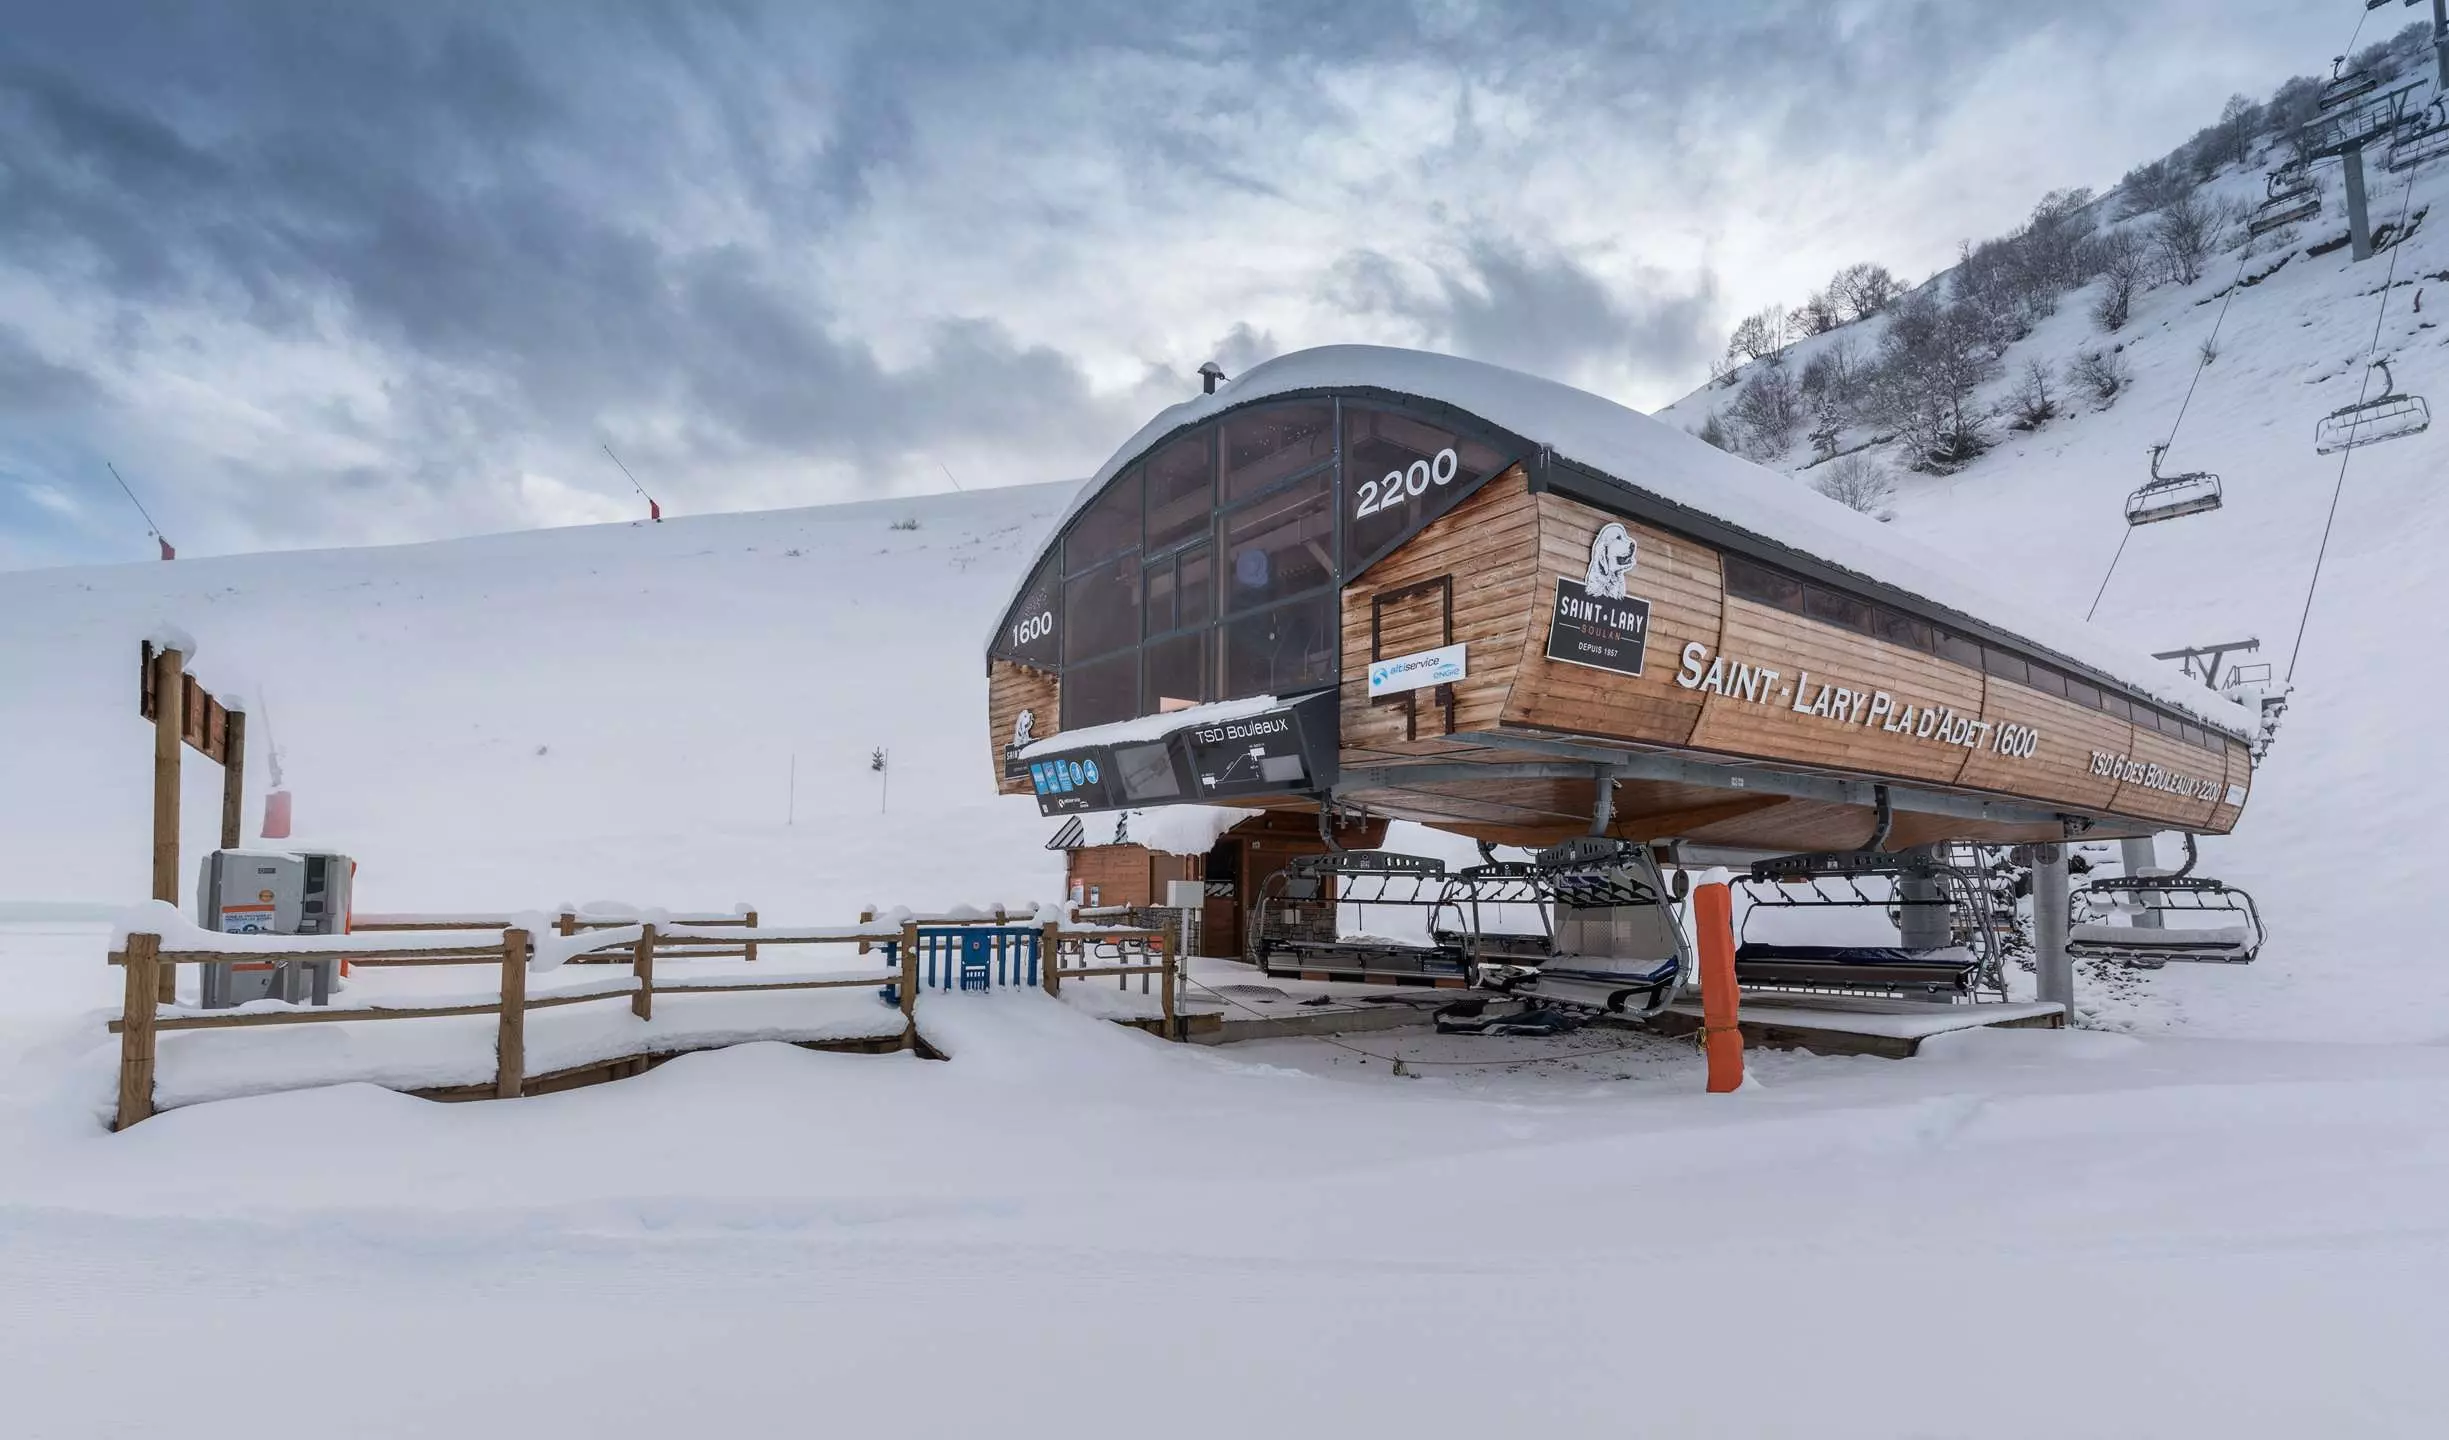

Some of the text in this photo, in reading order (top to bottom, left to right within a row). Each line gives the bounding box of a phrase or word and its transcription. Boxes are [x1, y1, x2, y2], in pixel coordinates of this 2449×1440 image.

[1357, 448, 1458, 520] 2200
[1012, 611, 1053, 647] 1600
[1581, 624, 1621, 641] SOULAN
[1578, 642, 1602, 654] DEPUIS
[1390, 657, 1440, 675] altiservice
[1195, 718, 1289, 744] TSD Bouleaux
[1865, 690, 1914, 735] PLA
[1993, 721, 2038, 759] 1600
[2089, 750, 2113, 776] TSD
[2113, 753, 2125, 780] 6
[2121, 760, 2146, 785] DES
[2144, 763, 2197, 797] BOULEAUX
[2198, 780, 2222, 801] 2200
